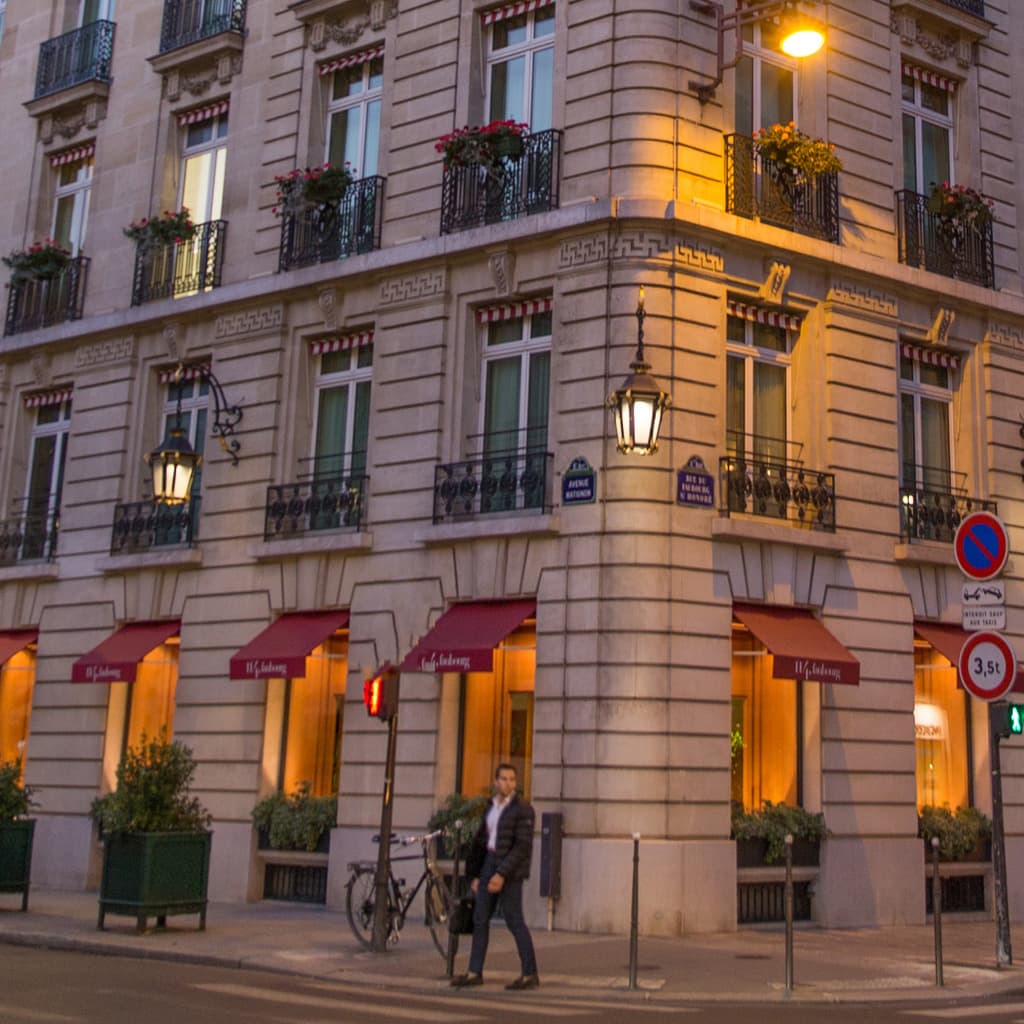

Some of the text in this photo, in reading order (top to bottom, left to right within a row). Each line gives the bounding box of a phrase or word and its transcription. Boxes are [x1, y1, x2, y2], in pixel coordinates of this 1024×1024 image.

[568, 478, 589, 488] AVENUE
[565, 489, 592, 499] MATIGNON
[974, 657, 1001, 677] 3,5t
